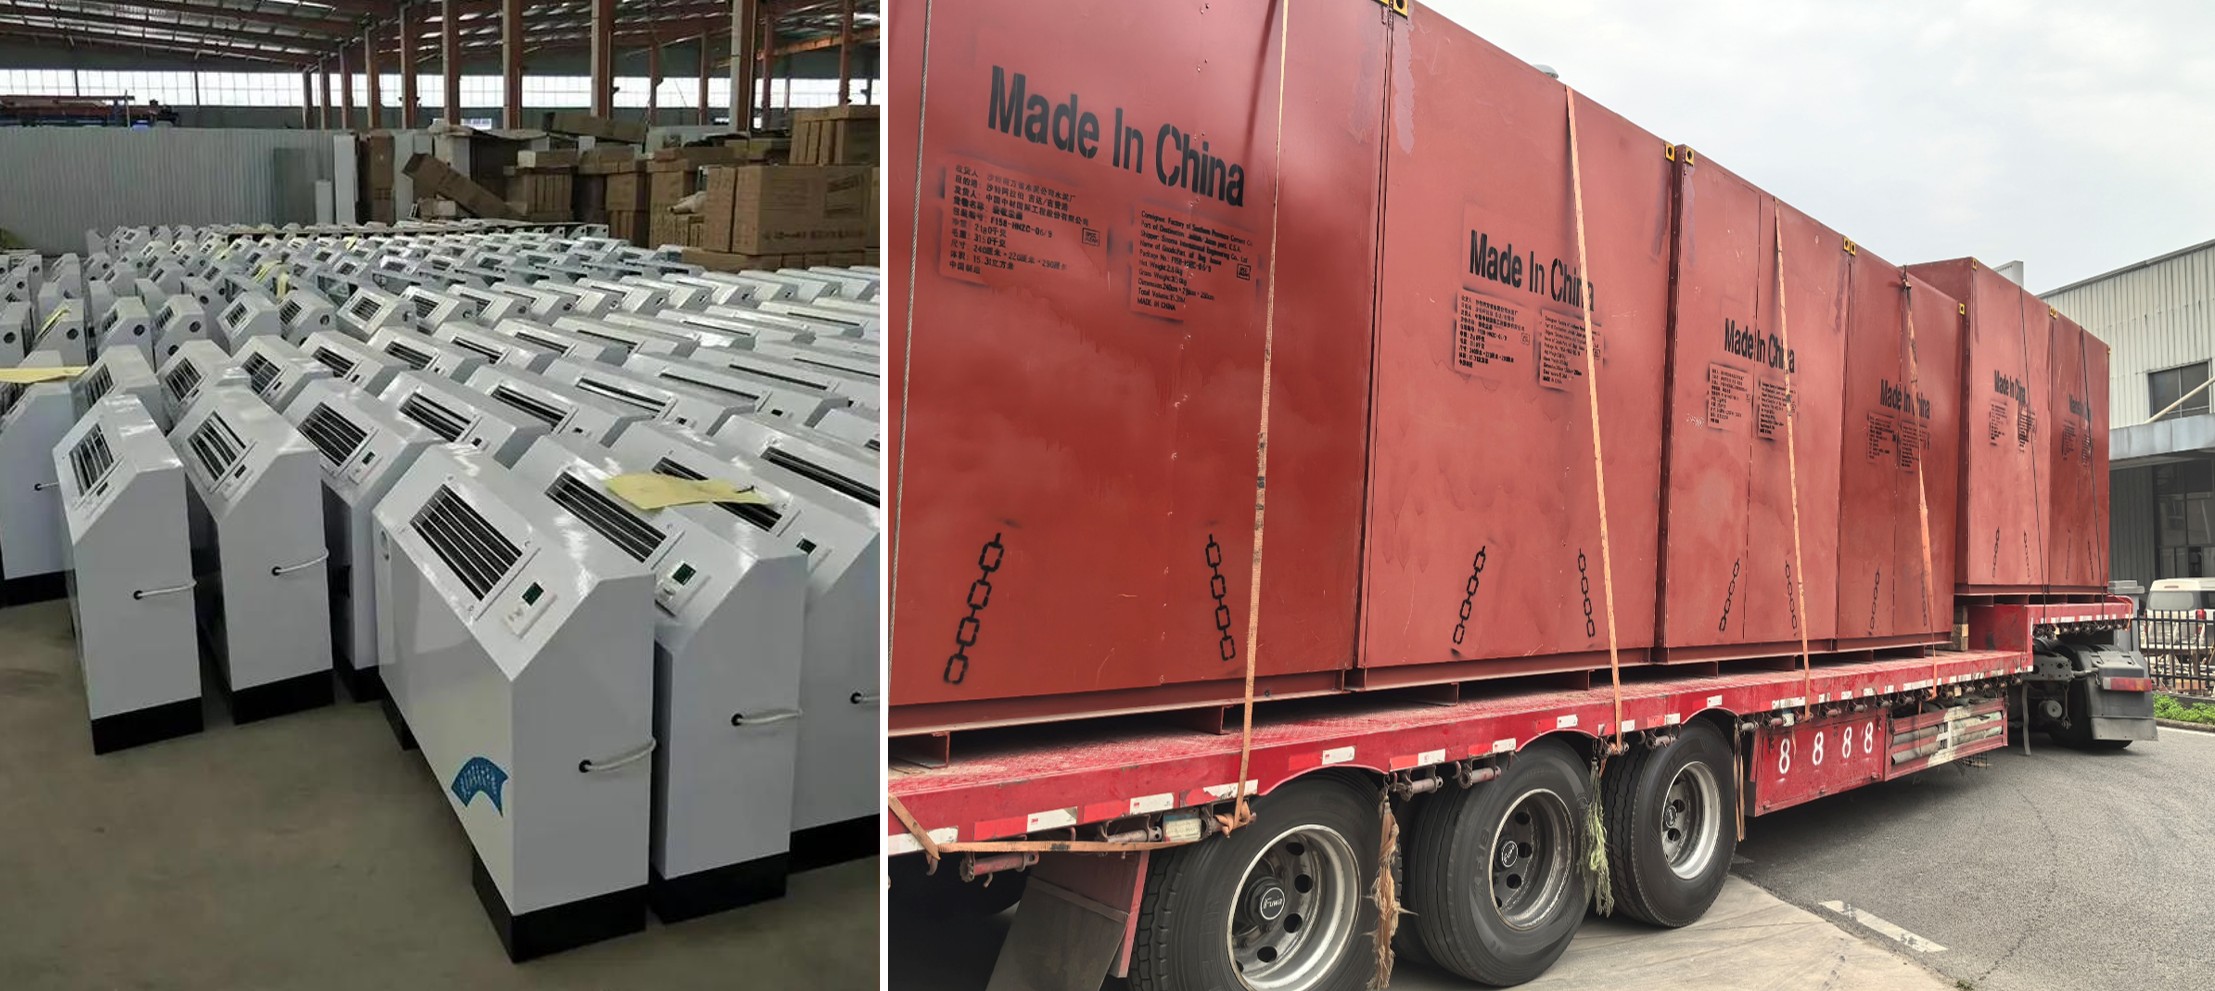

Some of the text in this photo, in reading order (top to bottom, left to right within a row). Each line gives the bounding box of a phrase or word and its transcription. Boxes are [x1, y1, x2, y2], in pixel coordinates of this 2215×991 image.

[988, 65, 1245, 207] Made In China
[1469, 229, 1522, 288] Made
[1529, 251, 1545, 295] In
[1724, 318, 1795, 373] Made In Chia
[1880, 378, 1902, 411] Made
[1904, 385, 1911, 413] In
